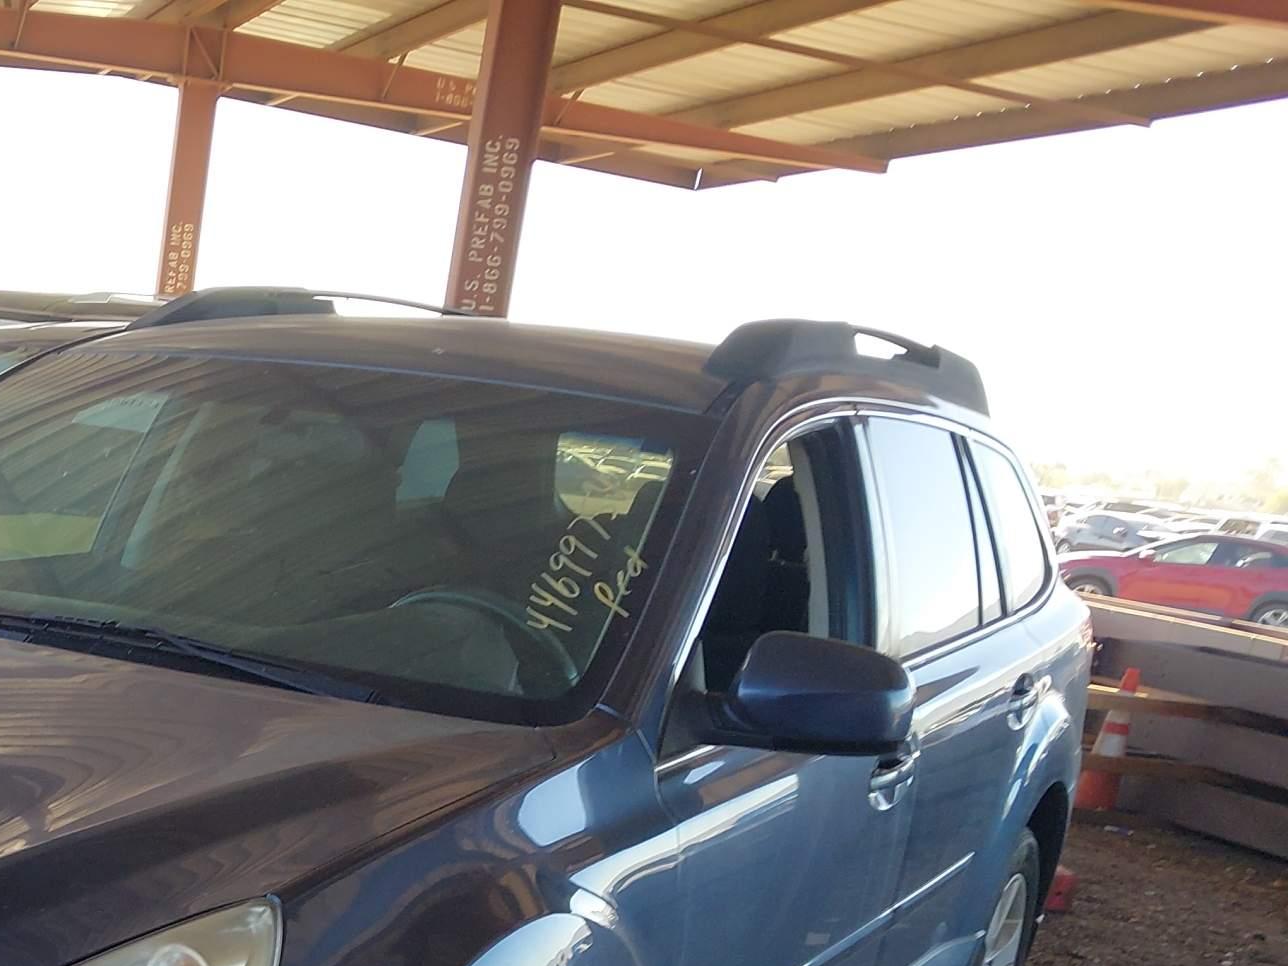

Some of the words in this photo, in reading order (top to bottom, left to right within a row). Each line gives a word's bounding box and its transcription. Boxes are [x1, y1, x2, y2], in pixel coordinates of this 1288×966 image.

[482, 135, 503, 173] INC.
[468, 184, 495, 263] PREFAB
[479, 137, 519, 312] 1-866-799-0969
[164, 251, 180, 293] REFAB
[176, 223, 194, 289] 799-0969
[461, 273, 480, 311] U.S.
